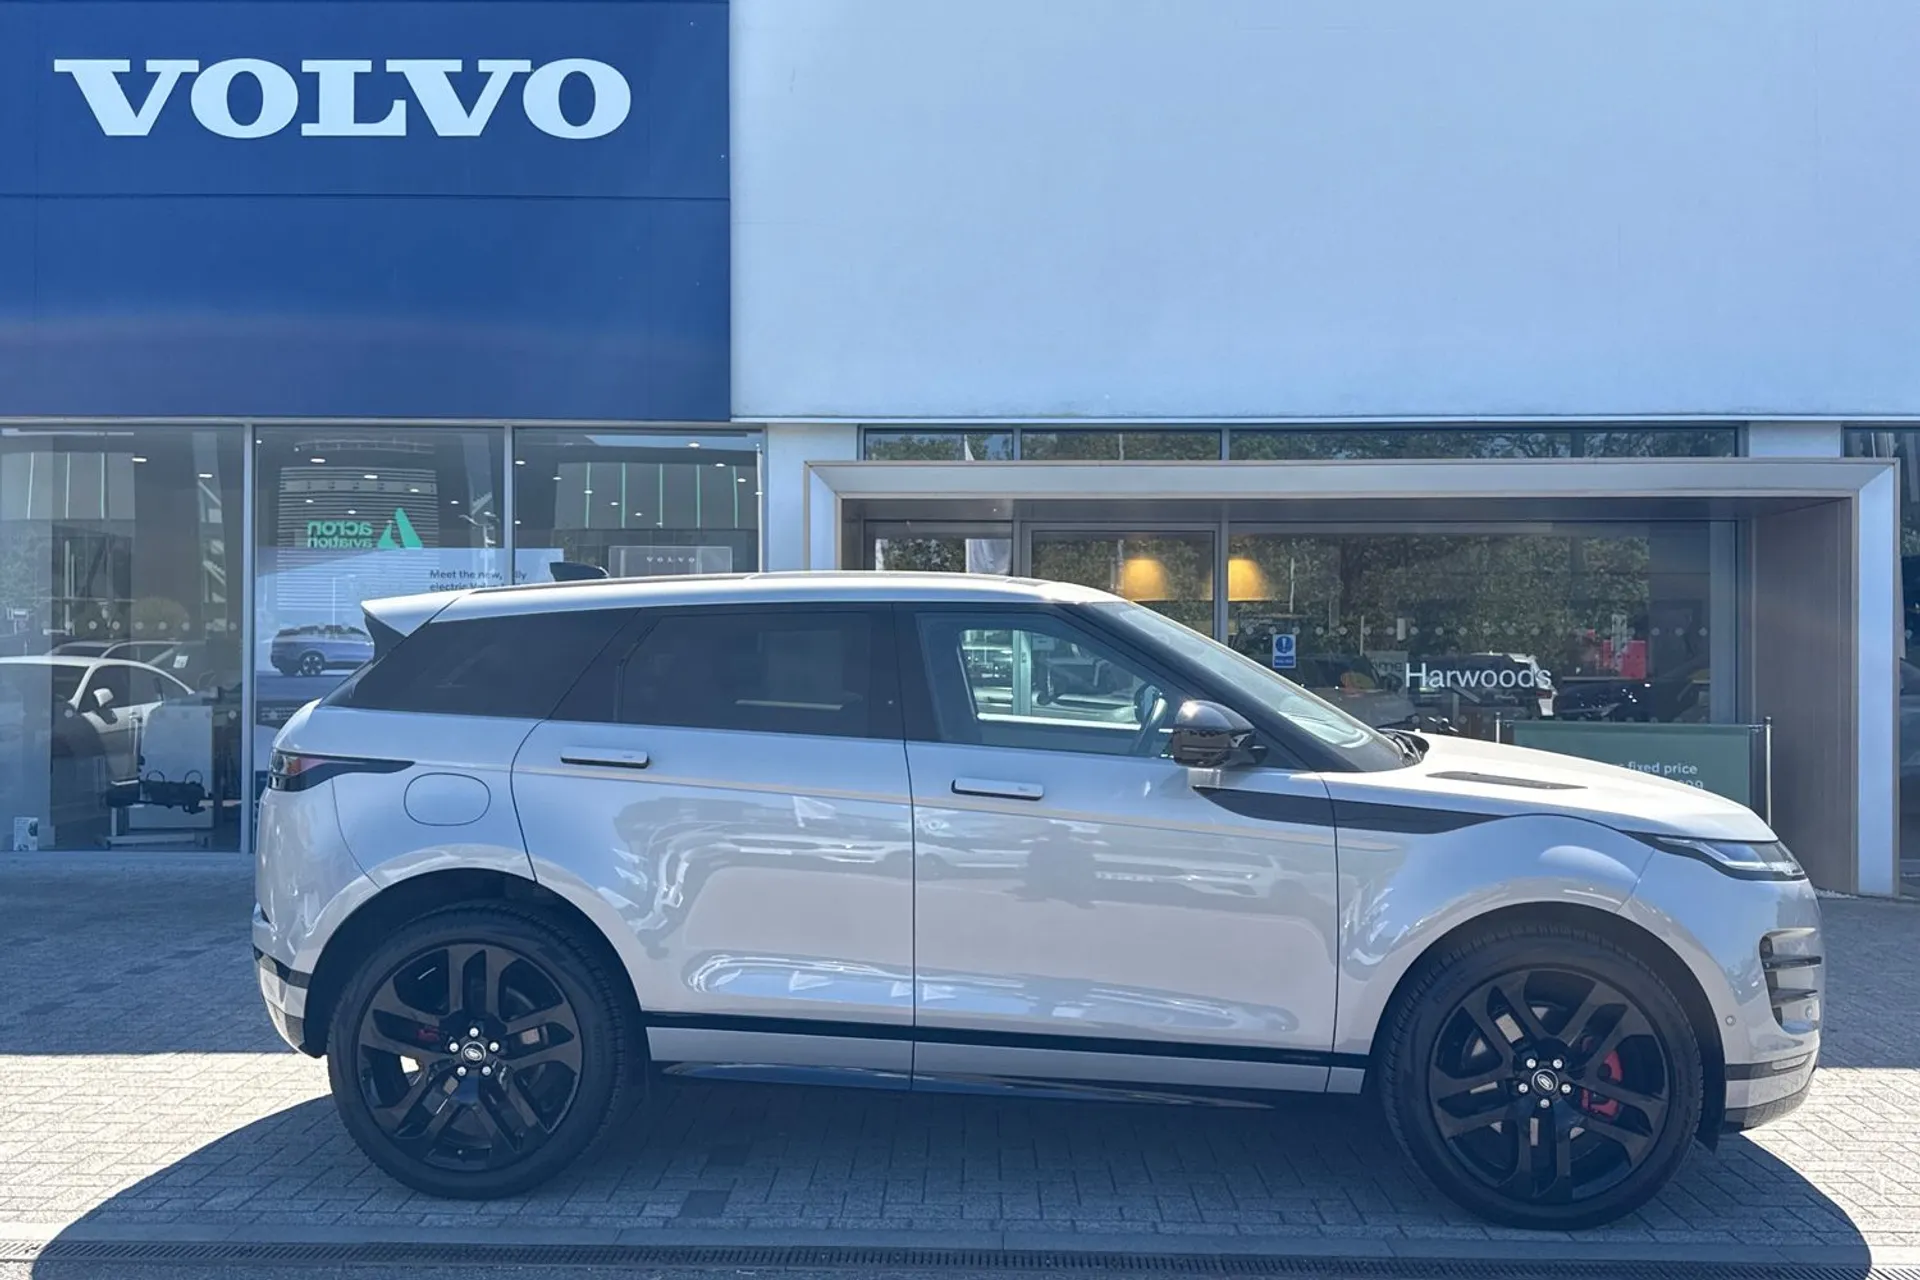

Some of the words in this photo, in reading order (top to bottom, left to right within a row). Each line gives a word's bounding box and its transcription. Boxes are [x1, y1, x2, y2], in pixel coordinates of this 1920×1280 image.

[54, 58, 632, 139] VOLVO
[646, 556, 695, 564] VOLVO
[430, 569, 457, 579] Meet
[459, 569, 476, 579] the
[1405, 662, 1552, 688] Harwoods
[1628, 761, 1660, 774] fixed
[1664, 763, 1699, 776] price
